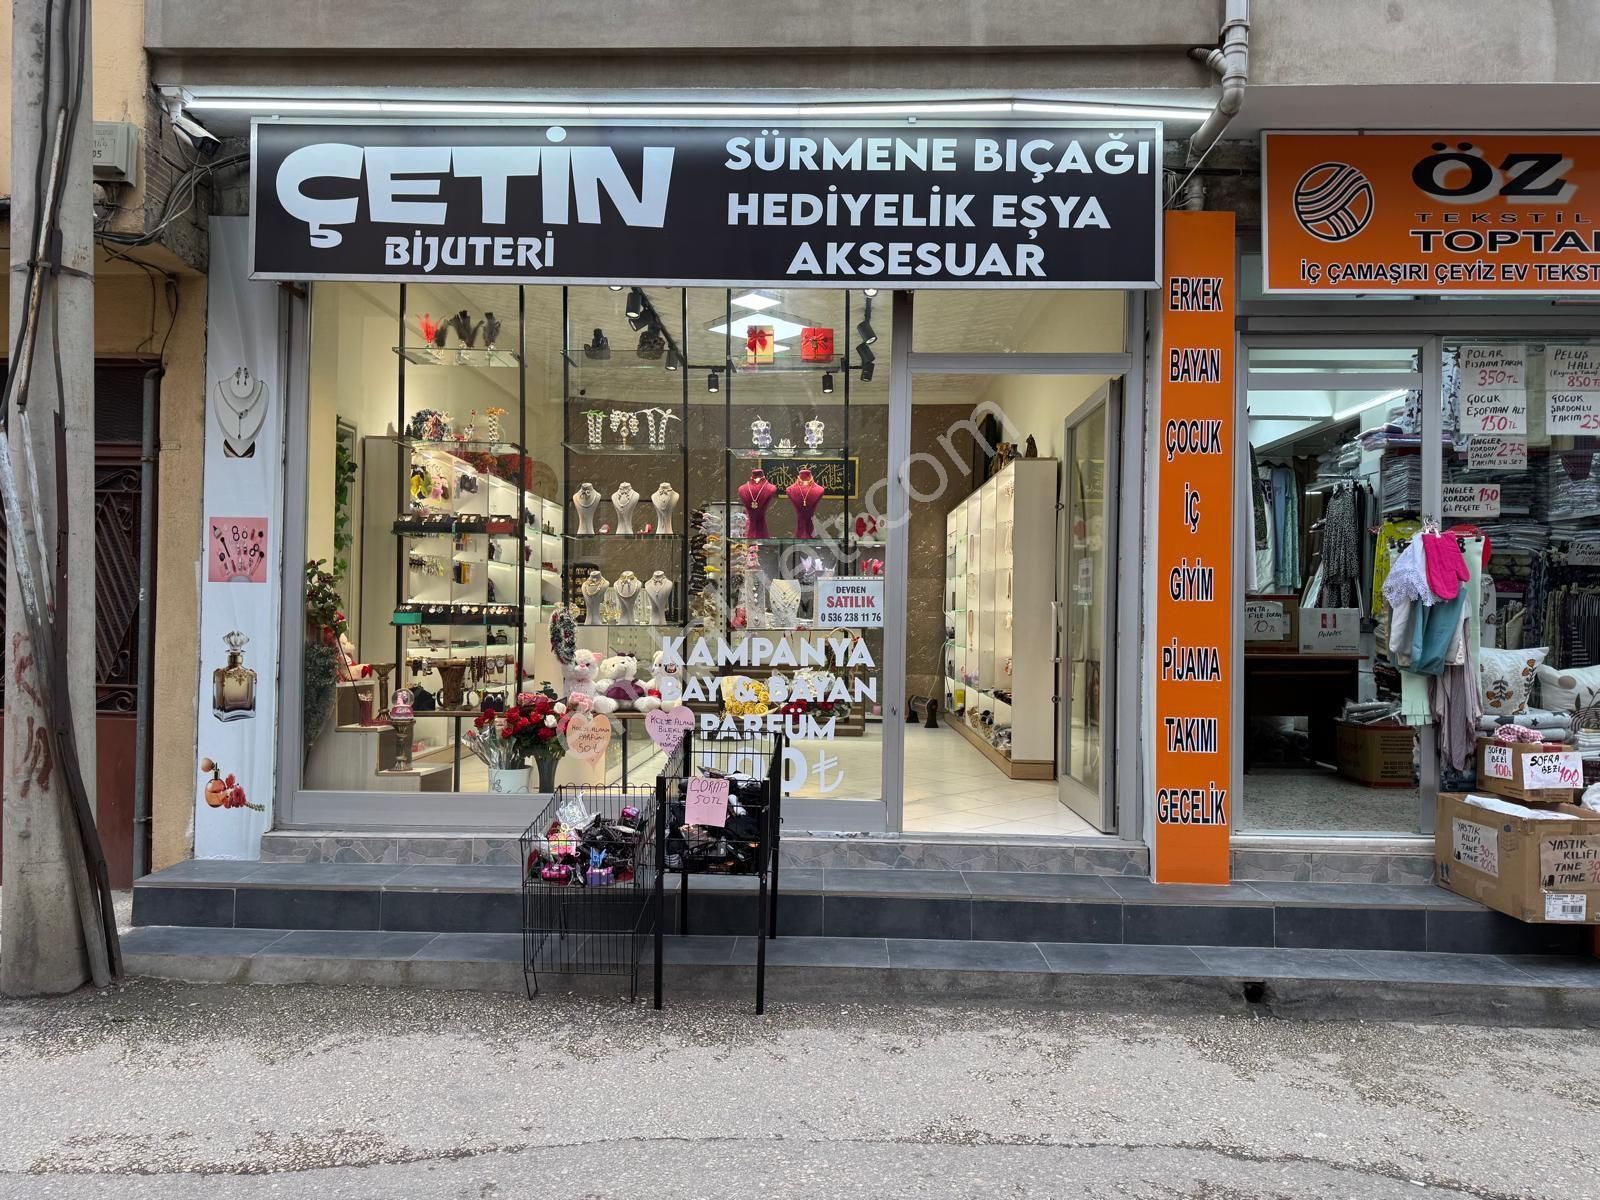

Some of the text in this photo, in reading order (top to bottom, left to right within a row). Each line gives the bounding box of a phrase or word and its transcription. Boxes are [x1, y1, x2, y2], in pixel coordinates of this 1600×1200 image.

[724, 129, 1149, 183] SÜRMENE BIÇAĞI
[1411, 142, 1574, 203] ÖZ
[276, 126, 675, 248] ÇETİN
[727, 184, 1111, 240] HEDİYELİK EŞYA
[1415, 210, 1592, 224] TEKSTİL
[1409, 229, 1600, 254] TOPTA
[385, 230, 554, 272] BİJUTERİ
[786, 241, 1047, 277] AKSESUAR
[1300, 258, 1321, 284] İÇ
[1327, 261, 1429, 284] ÇAMAŞIRI
[1434, 259, 1495, 284] ÇEYİZ
[1501, 263, 1529, 281] EV
[1169, 277, 1223, 311] ERKEK
[1467, 350, 1503, 358] POLAR
[1169, 348, 1221, 383] BAYAN
[1568, 361, 1592, 370] HALI
[1478, 370, 1506, 387] 350
[1567, 376, 1591, 387] 850
[1467, 395, 1501, 404] ÇOCUK
[1551, 395, 1584, 404] ÇOCUK
[1466, 406, 1525, 416] EŞOFMAN ALT
[1551, 415, 1582, 423] TAKIM
[1481, 415, 1508, 431] 150
[1166, 419, 1222, 462] ÇOCUK
[1478, 487, 1499, 502] 150
[1184, 481, 1200, 533] İÇ
[1170, 558, 1214, 601] GİYİM
[836, 586, 866, 594] DEVREN
[826, 595, 875, 609] SATILIK
[821, 612, 881, 622] 0 536 238 11 76
[662, 636, 876, 668] KAMPANYA
[1162, 637, 1221, 681] PİJAMA
[660, 676, 877, 703] BAY & BAYAN
[1164, 717, 1217, 753] TAKIMI
[1531, 755, 1560, 766] SOFRA
[1559, 767, 1579, 783] 100
[690, 778, 726, 795] ÇORAP
[1157, 781, 1227, 825] GECELİK
[1457, 822, 1480, 835] YASTIK
[1548, 839, 1588, 851] YASTIK
[1564, 850, 1597, 860] KILIFI
[1554, 862, 1582, 872] TANE
[1558, 873, 1586, 884] TANE
